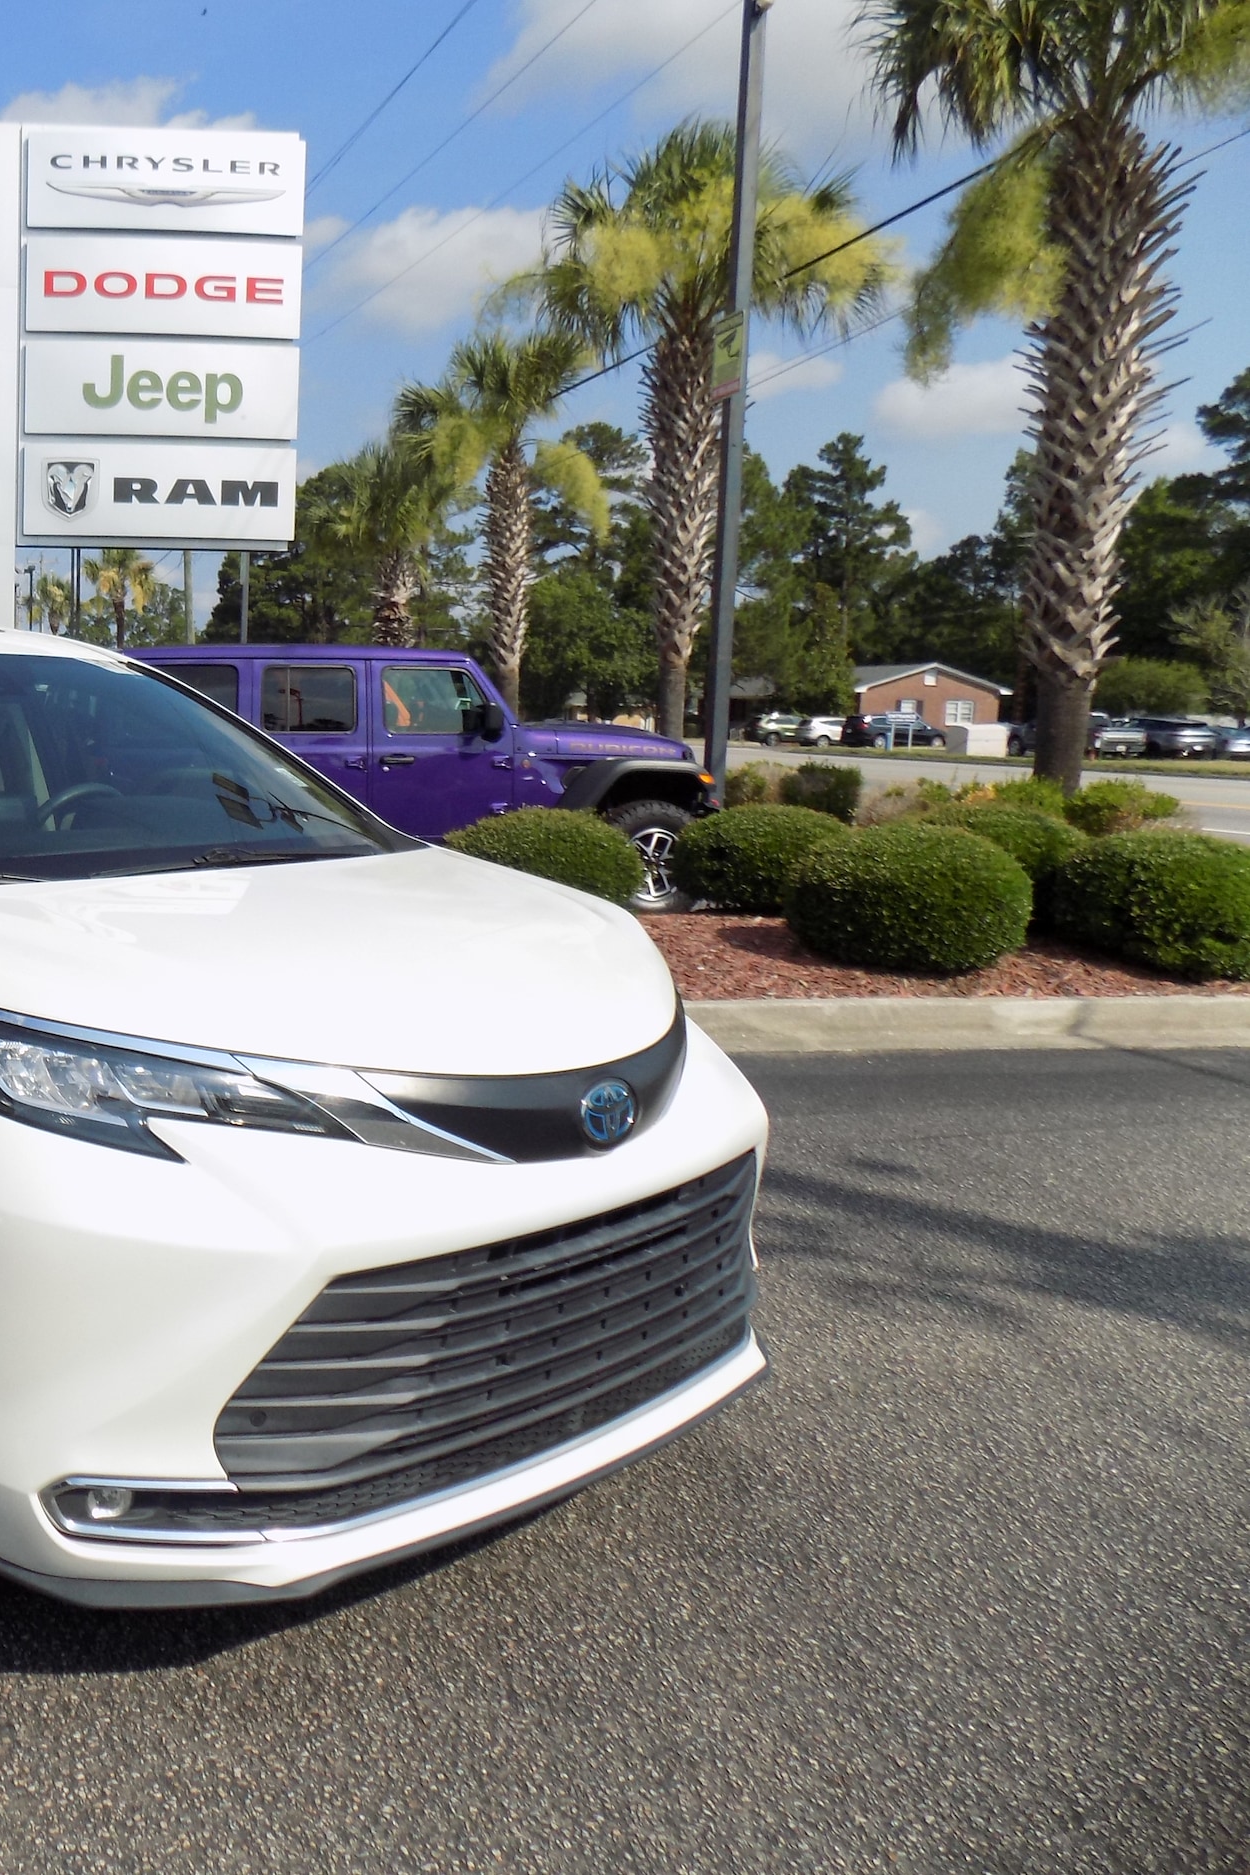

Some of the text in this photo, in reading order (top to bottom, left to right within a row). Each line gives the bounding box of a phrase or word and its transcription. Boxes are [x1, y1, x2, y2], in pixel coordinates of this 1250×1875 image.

[50, 154, 281, 176] CHRYSLER
[44, 270, 284, 305] DODGE
[82, 354, 244, 424] Jeep
[113, 477, 279, 507] RAM
[569, 742, 677, 756] RUBICON
